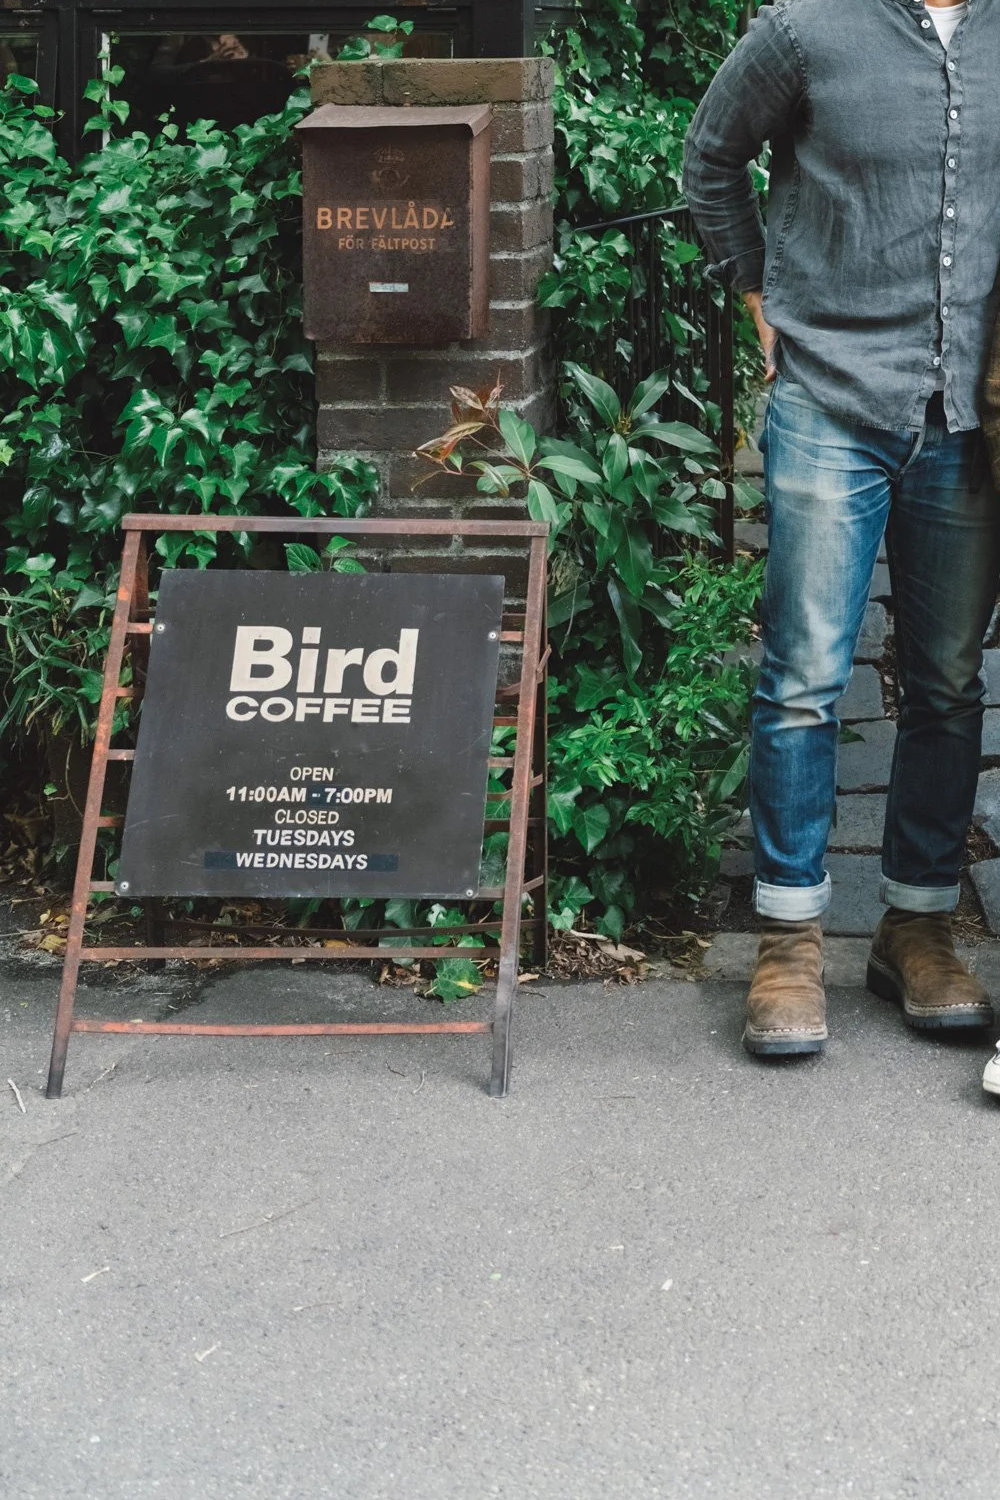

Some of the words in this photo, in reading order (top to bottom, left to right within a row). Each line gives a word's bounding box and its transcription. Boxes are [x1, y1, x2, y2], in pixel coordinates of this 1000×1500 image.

[316, 201, 456, 230] BREVLÅDA
[338, 235, 365, 250] FÖR
[229, 625, 420, 696] Bird
[225, 696, 412, 724] COFFEE
[290, 767, 334, 782] OPEN
[226, 786, 307, 803] 11:00AM
[324, 788, 393, 804] 7:00PM
[274, 809, 340, 825] CLOSED
[253, 829, 356, 847] TUESDAYS
[235, 852, 369, 870] WEDNESDAYS
